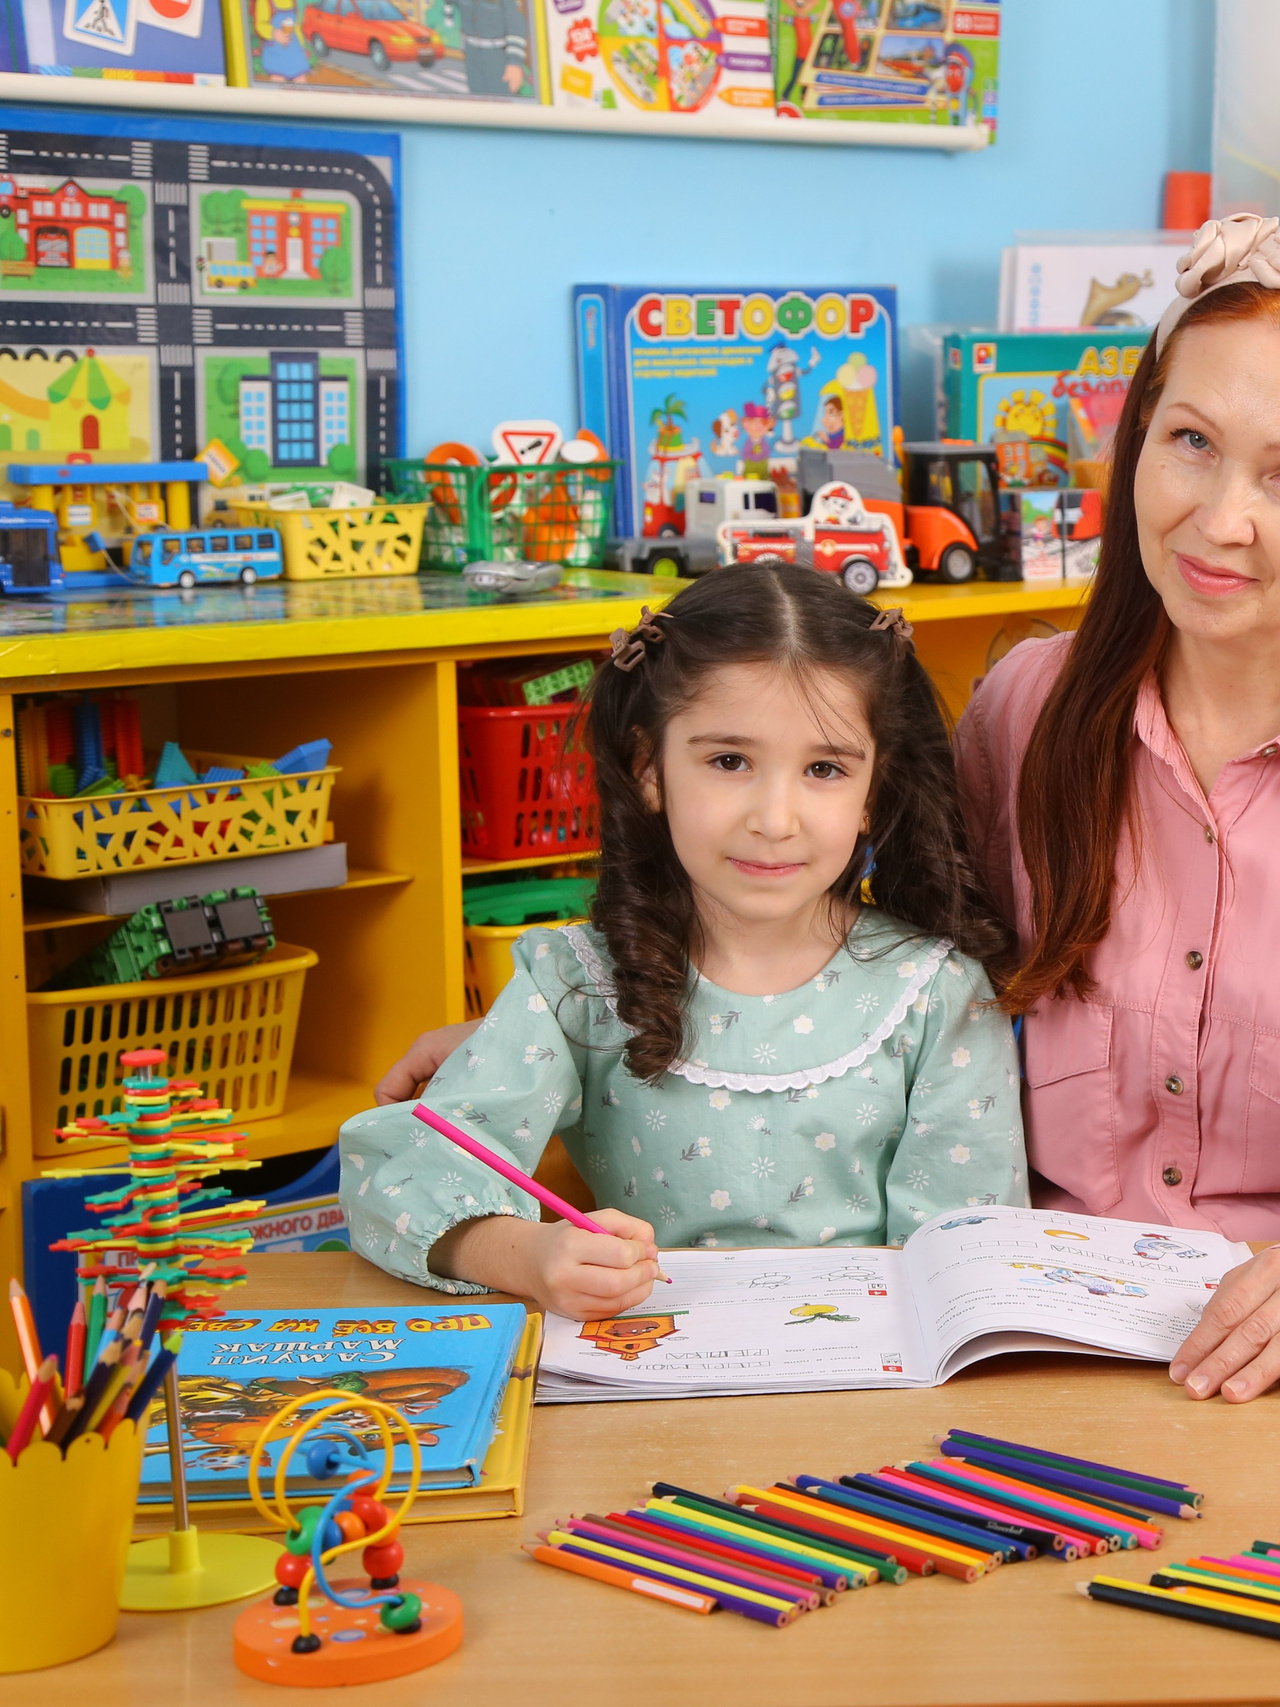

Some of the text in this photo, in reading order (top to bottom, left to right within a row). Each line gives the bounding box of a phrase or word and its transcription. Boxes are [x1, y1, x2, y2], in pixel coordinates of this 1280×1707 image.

[637, 296, 876, 337] СВЕТОФОР
[1078, 346, 1146, 378] АЗБ
[165, 1313, 493, 1338] ПРО ВСЁ НА СВЕТ
[212, 1338, 406, 1353] МАРШАК
[208, 1351, 396, 1366] САМУИЛ
